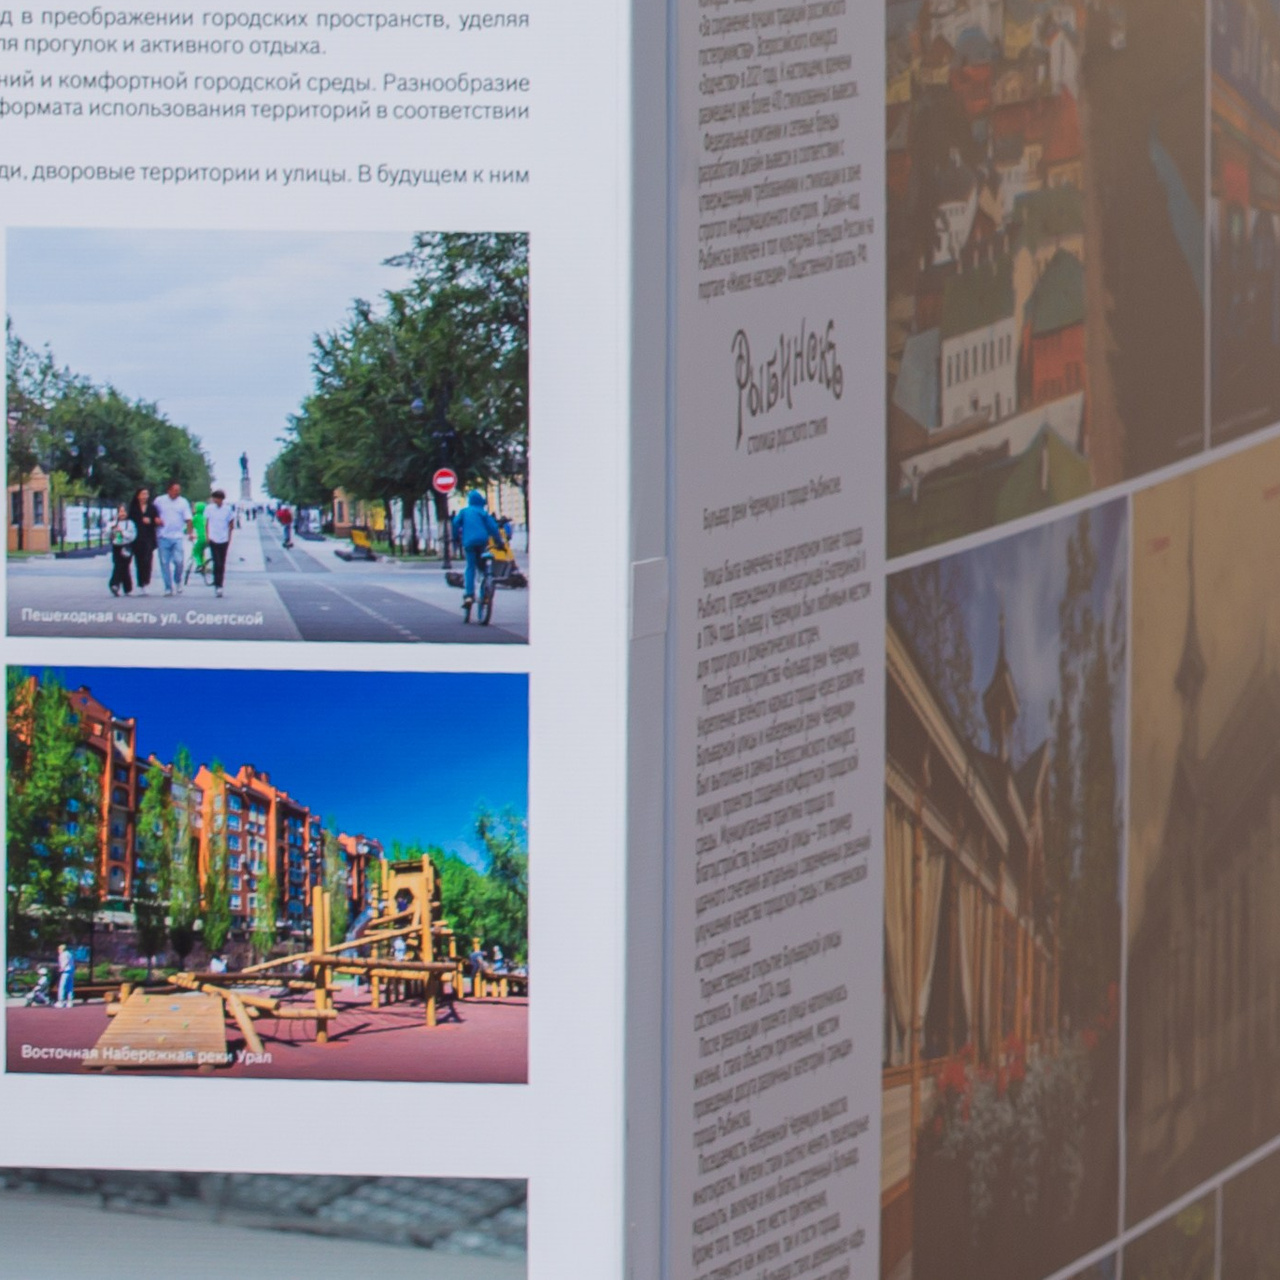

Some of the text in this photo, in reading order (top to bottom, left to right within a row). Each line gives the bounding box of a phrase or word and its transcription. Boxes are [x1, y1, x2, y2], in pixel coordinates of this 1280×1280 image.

[20, 10, 34, 25] в
[41, 5, 194, 30] преображении
[202, 11, 309, 31] городских
[316, 12, 451, 32] пространств,
[458, 13, 530, 33] уделяя
[23, 37, 118, 57] прогулок
[122, 39, 135, 53] и
[139, 38, 245, 55] активного
[248, 39, 327, 57] отдыха.
[40, 74, 53, 89] и
[58, 69, 188, 94] комфортной
[194, 72, 302, 94] городской
[306, 76, 377, 95] среды.
[382, 71, 531, 96] Разнообразие
[88, 101, 247, 118] использования
[250, 100, 371, 123] территорий
[376, 104, 389, 120] в
[392, 104, 530, 120] соответствии
[31, 164, 136, 184] дворовые
[139, 165, 260, 186] территории
[265, 167, 278, 182] и
[282, 167, 352, 187] улицы.
[357, 163, 373, 183] В
[376, 162, 468, 188] будущем
[472, 169, 484, 183] к
[488, 169, 530, 184] ним
[21, 607, 264, 626] Пешеходная часть ул. Советской
[21, 1044, 272, 1065] Восточная Набережная реки Урал
